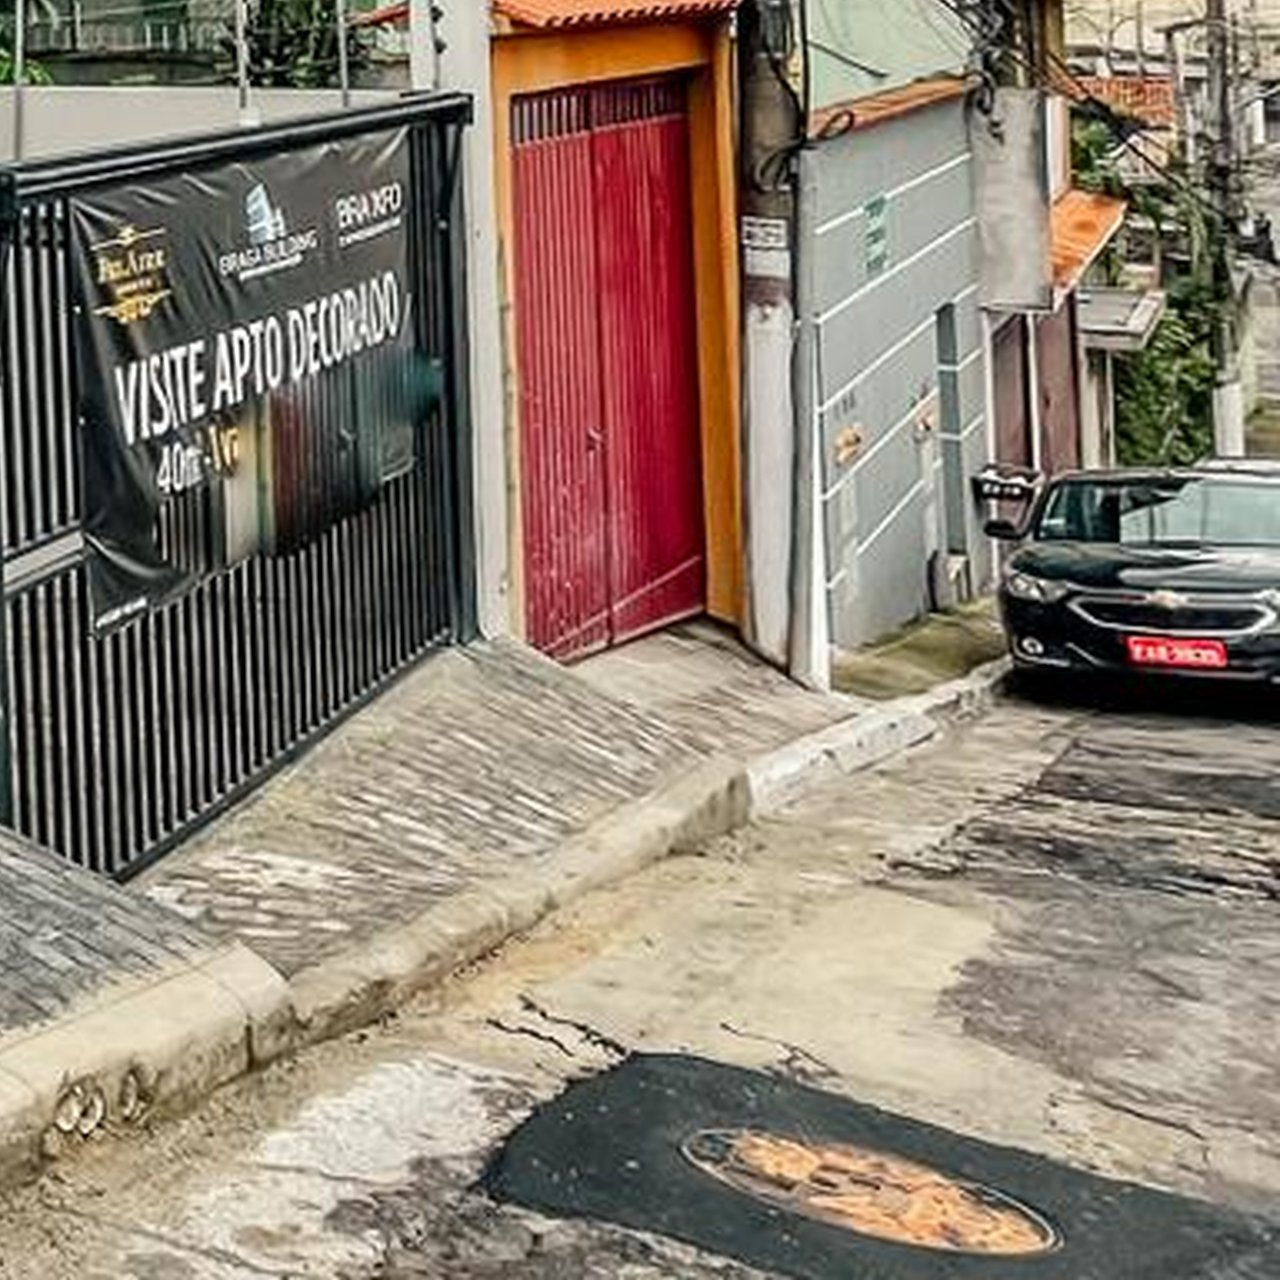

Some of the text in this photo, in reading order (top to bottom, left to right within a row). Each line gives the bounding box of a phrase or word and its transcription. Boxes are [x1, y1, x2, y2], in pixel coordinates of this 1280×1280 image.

[114, 271, 400, 445] VISITE APTO DECORADO
